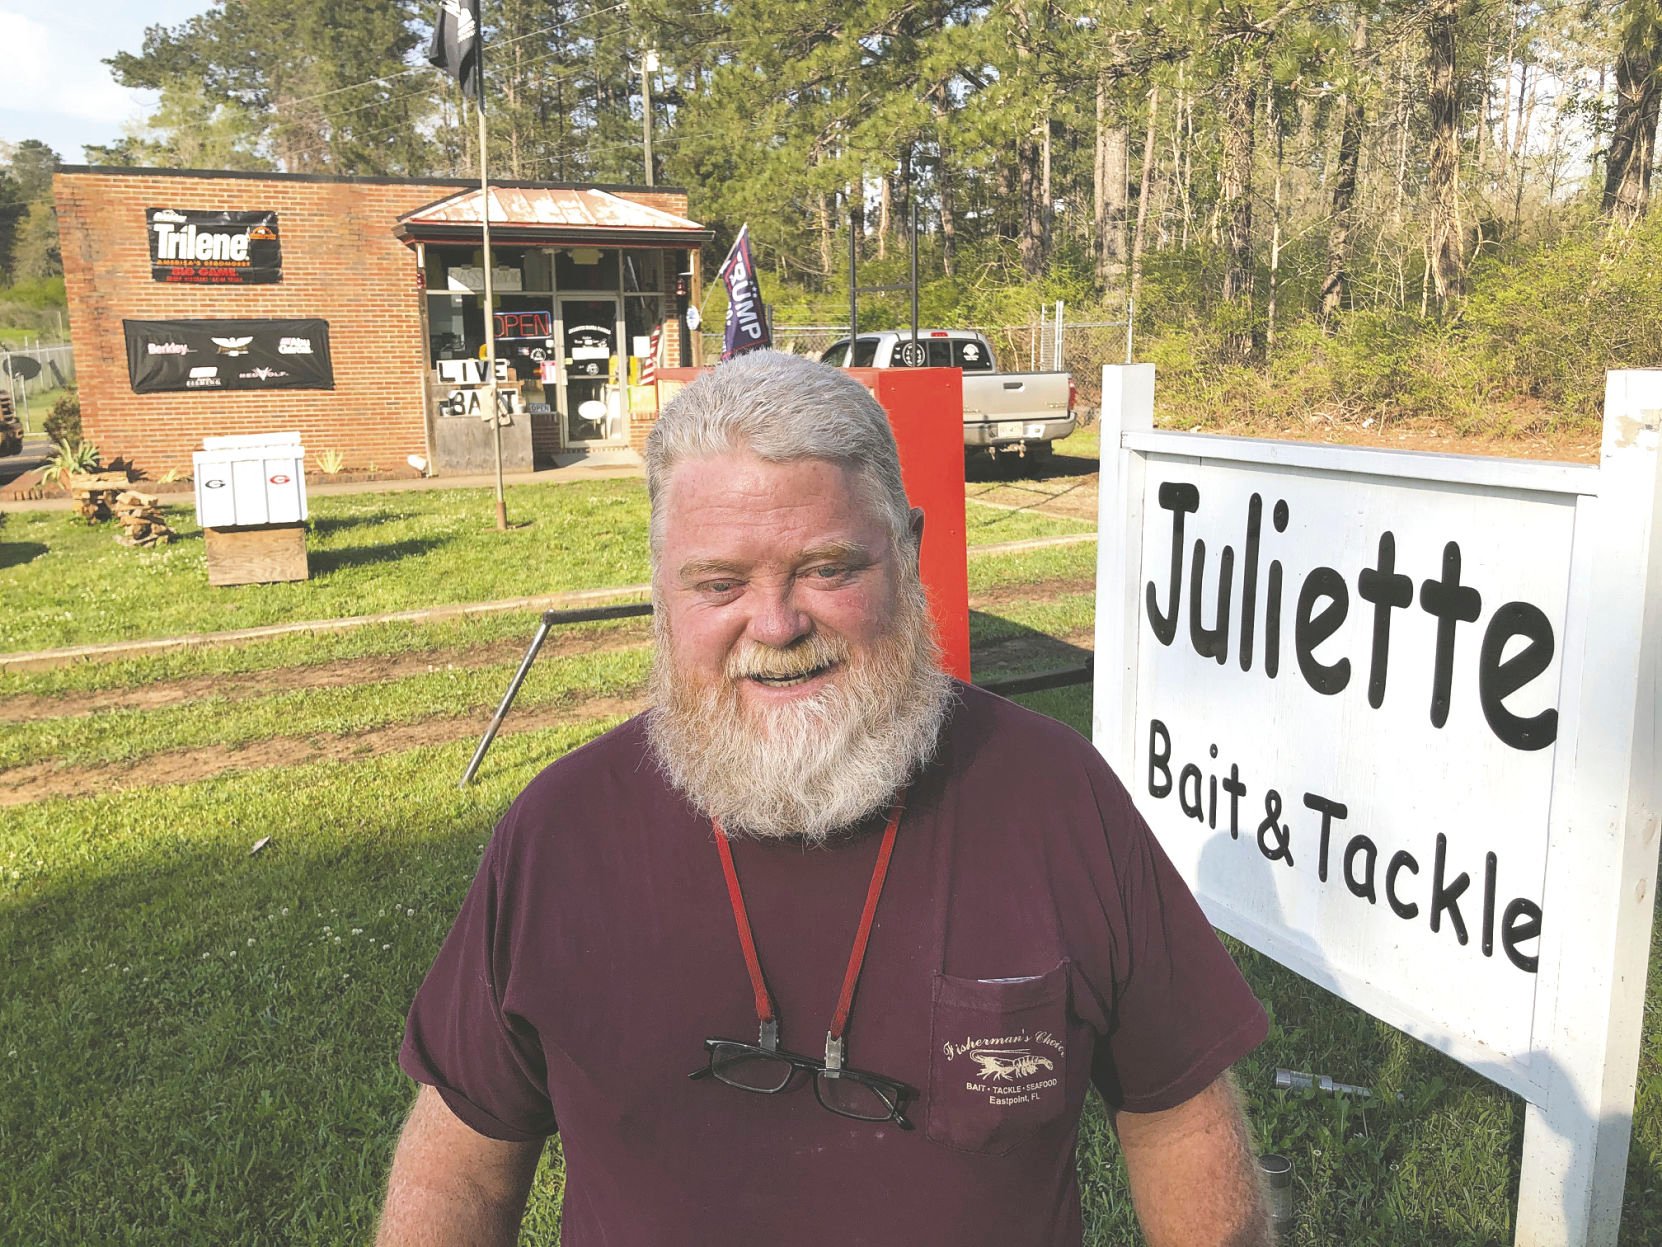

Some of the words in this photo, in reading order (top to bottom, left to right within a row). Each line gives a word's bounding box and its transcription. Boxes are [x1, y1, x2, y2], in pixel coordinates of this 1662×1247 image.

[153, 223, 249, 261] Trilene
[493, 313, 550, 337] OPEN
[439, 360, 506, 382] LIVE
[450, 390, 516, 415] BAT
[1146, 481, 1558, 751] Juliette
[1148, 718, 1247, 840] Bait
[1256, 789, 1295, 867] &
[1303, 792, 1543, 974] Tackle
[943, 1028, 1031, 1061] Fisherman's
[966, 1082, 987, 1092] BAIT
[993, 1085, 1022, 1094] TACKLE
[1026, 1078, 1059, 1091] SEAFOOD
[989, 1095, 1030, 1106] Eastpoint,
[1031, 1092, 1041, 1101] FL
